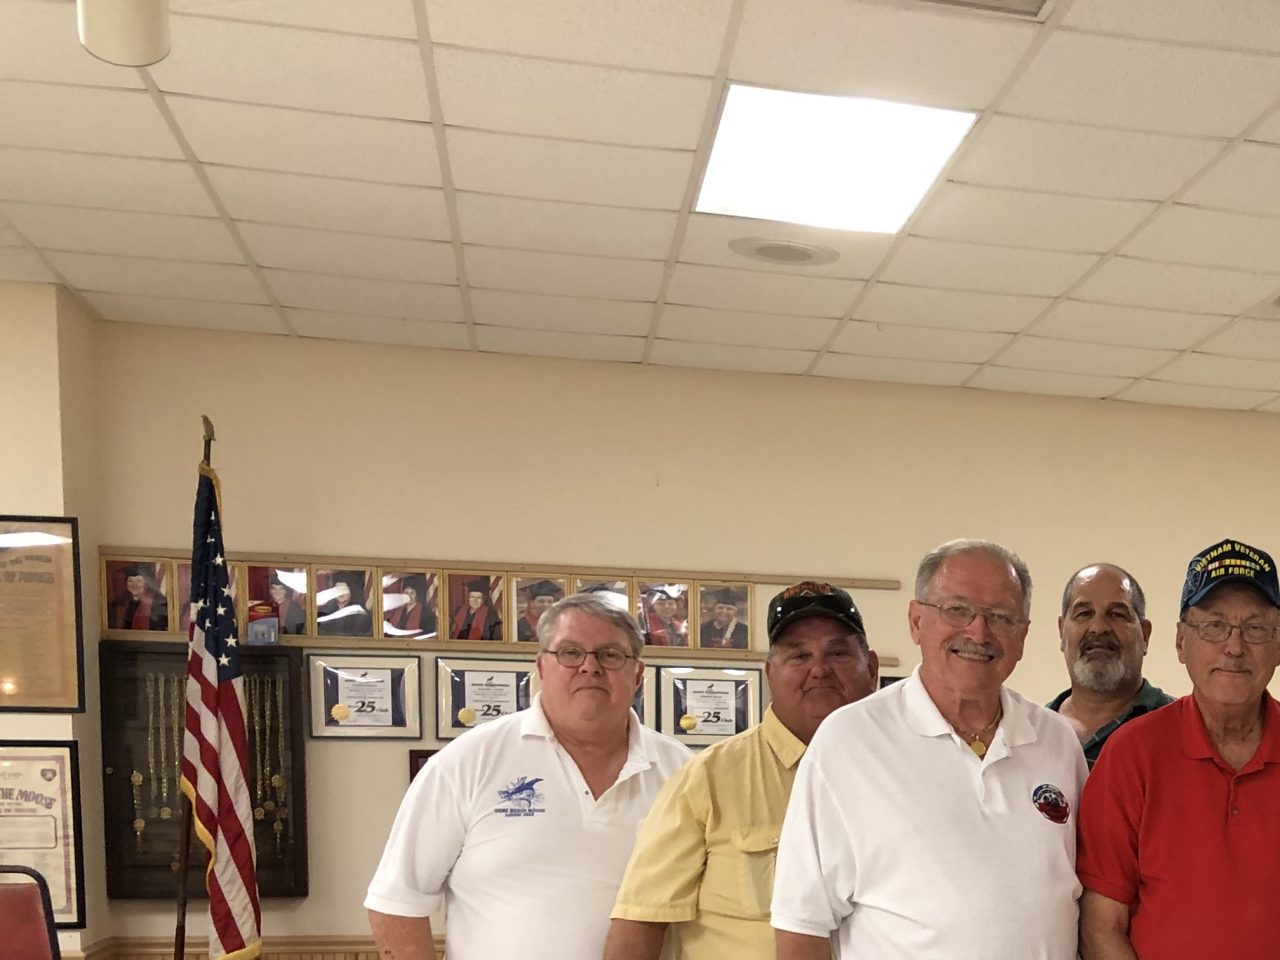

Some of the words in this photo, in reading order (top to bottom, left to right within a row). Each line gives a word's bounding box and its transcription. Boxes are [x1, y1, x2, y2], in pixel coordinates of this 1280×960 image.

[1194, 544, 1232, 572] VIETNAM
[1234, 543, 1271, 572] VETERAN
[1210, 568, 1225, 578] AIR
[1228, 567, 1255, 577] FORCE
[354, 700, 376, 713] 25
[480, 704, 501, 716] 25
[701, 711, 721, 723] 25
[15, 789, 56, 810] MOOSE
